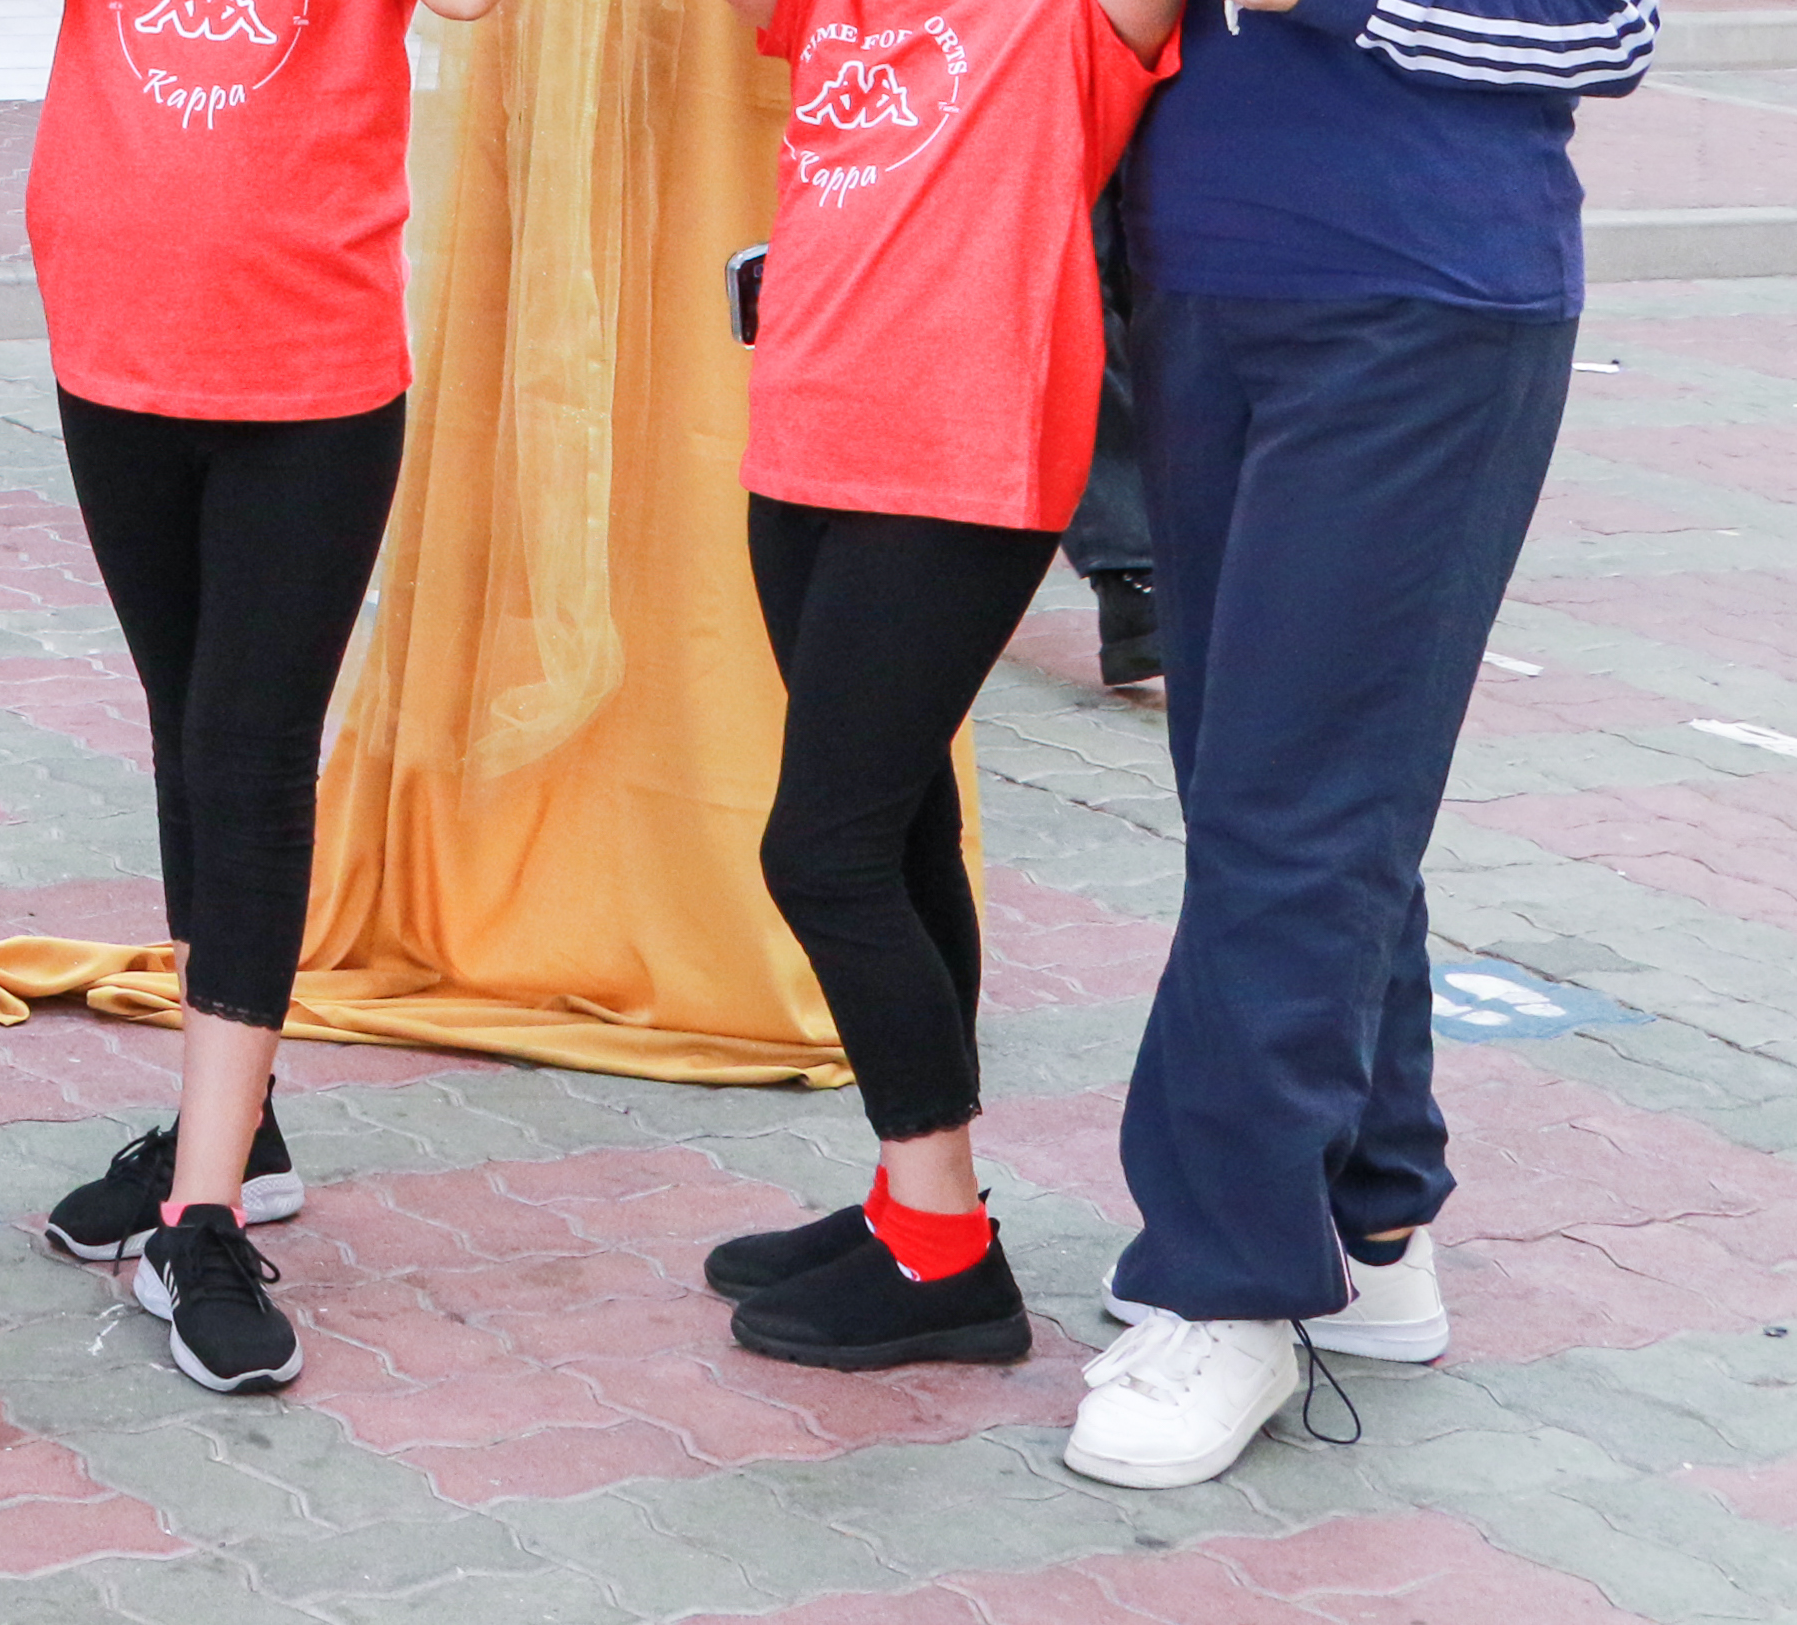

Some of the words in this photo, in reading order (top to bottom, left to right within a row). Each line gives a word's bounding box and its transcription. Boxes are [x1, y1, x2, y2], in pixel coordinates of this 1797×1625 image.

[800, 23, 858, 63] TIME
[923, 15, 968, 76] ORTS
[143, 68, 246, 130] Kappa
[799, 150, 877, 208] Kappa
